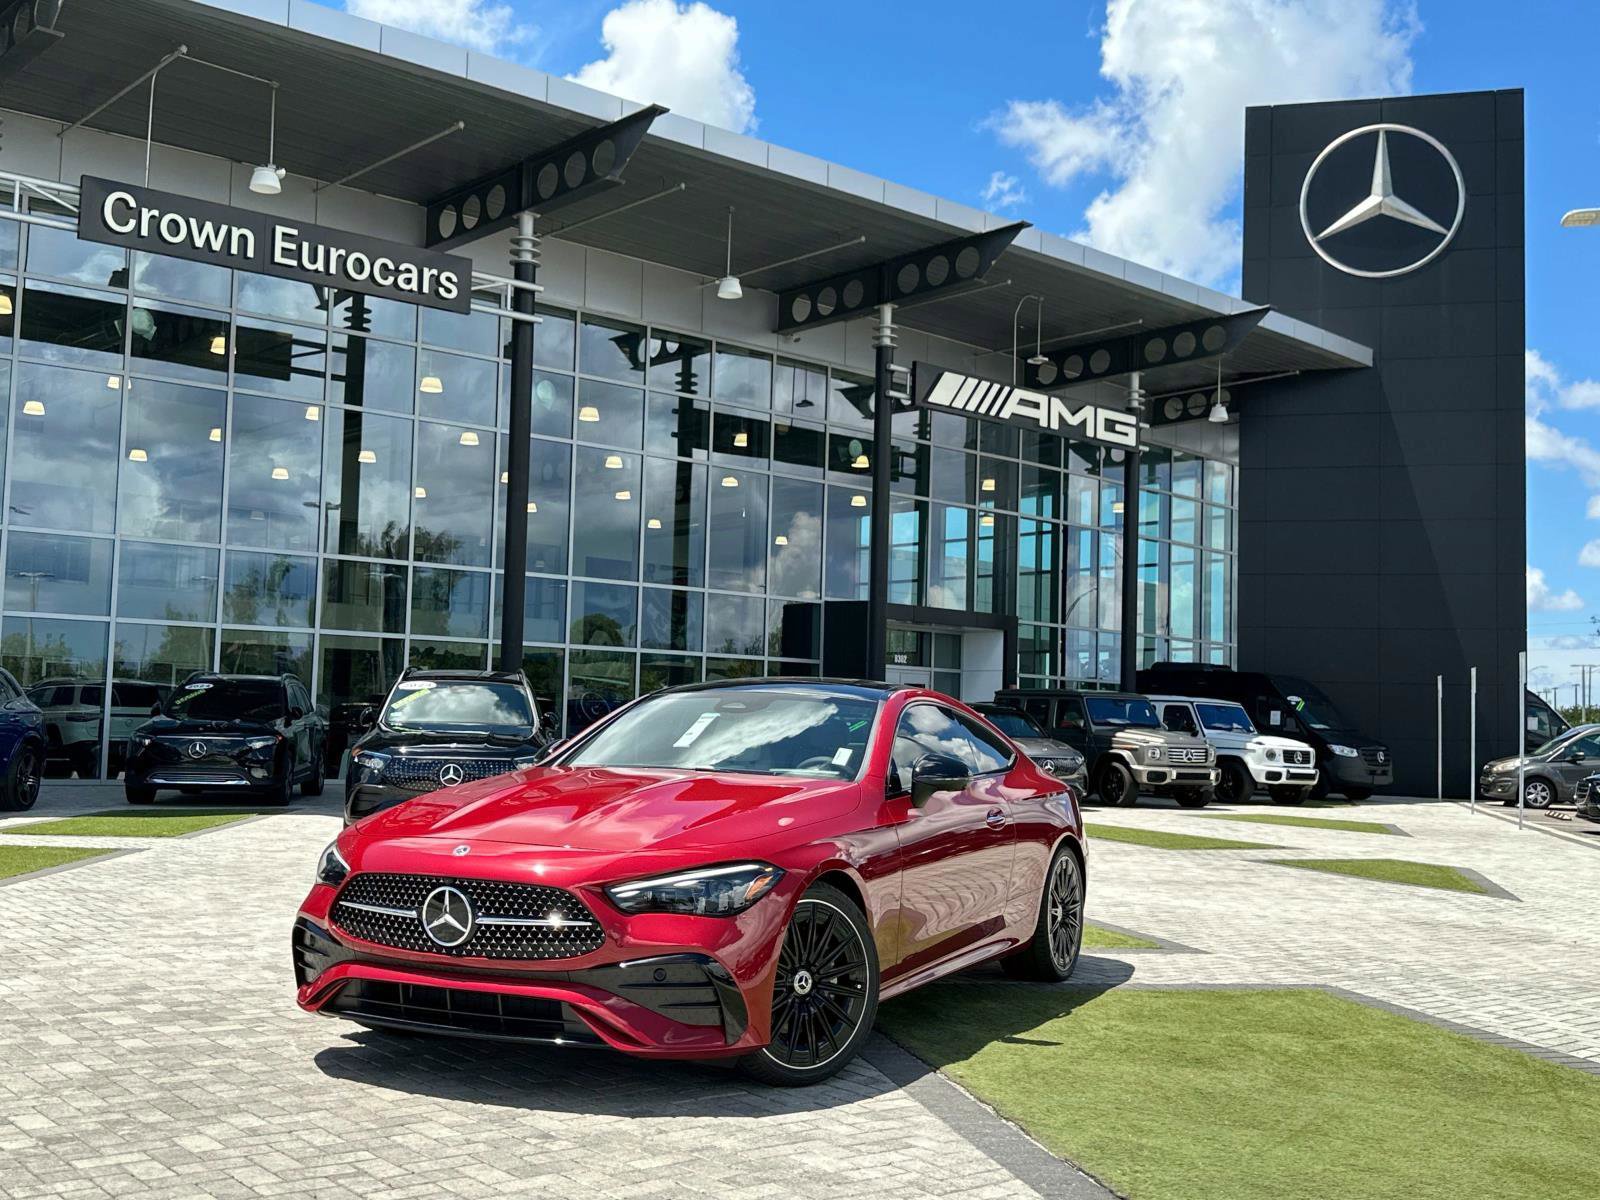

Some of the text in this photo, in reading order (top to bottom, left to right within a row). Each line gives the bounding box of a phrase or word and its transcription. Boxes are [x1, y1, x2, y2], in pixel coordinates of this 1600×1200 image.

[102, 190, 460, 301] Crown Eurocars
[998, 387, 1138, 448] AMG
